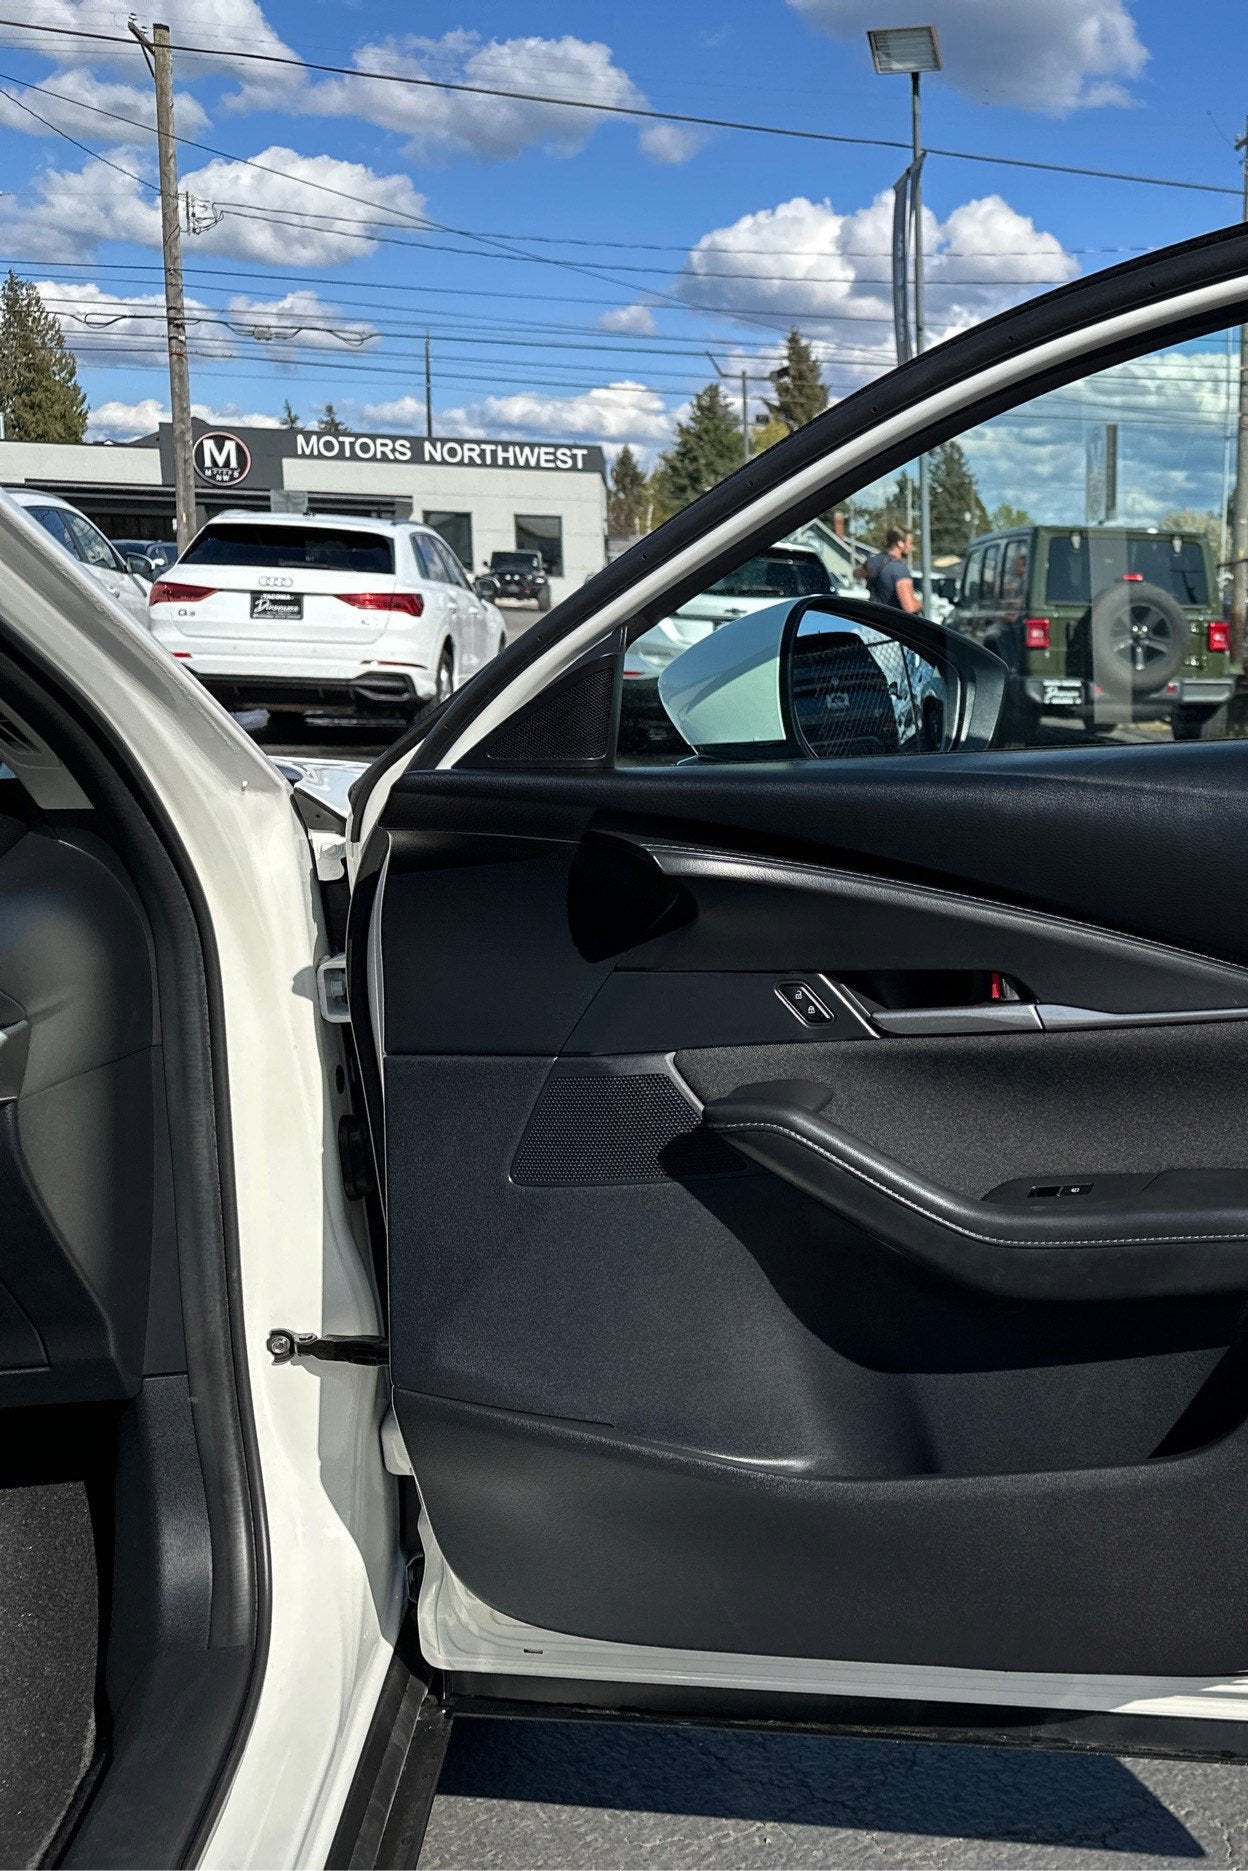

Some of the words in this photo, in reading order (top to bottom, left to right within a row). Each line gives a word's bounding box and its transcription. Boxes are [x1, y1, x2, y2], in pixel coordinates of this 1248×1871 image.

[202, 438, 239, 469] M
[296, 434, 411, 461] MOTORS
[423, 440, 588, 470] NORTHWEST
